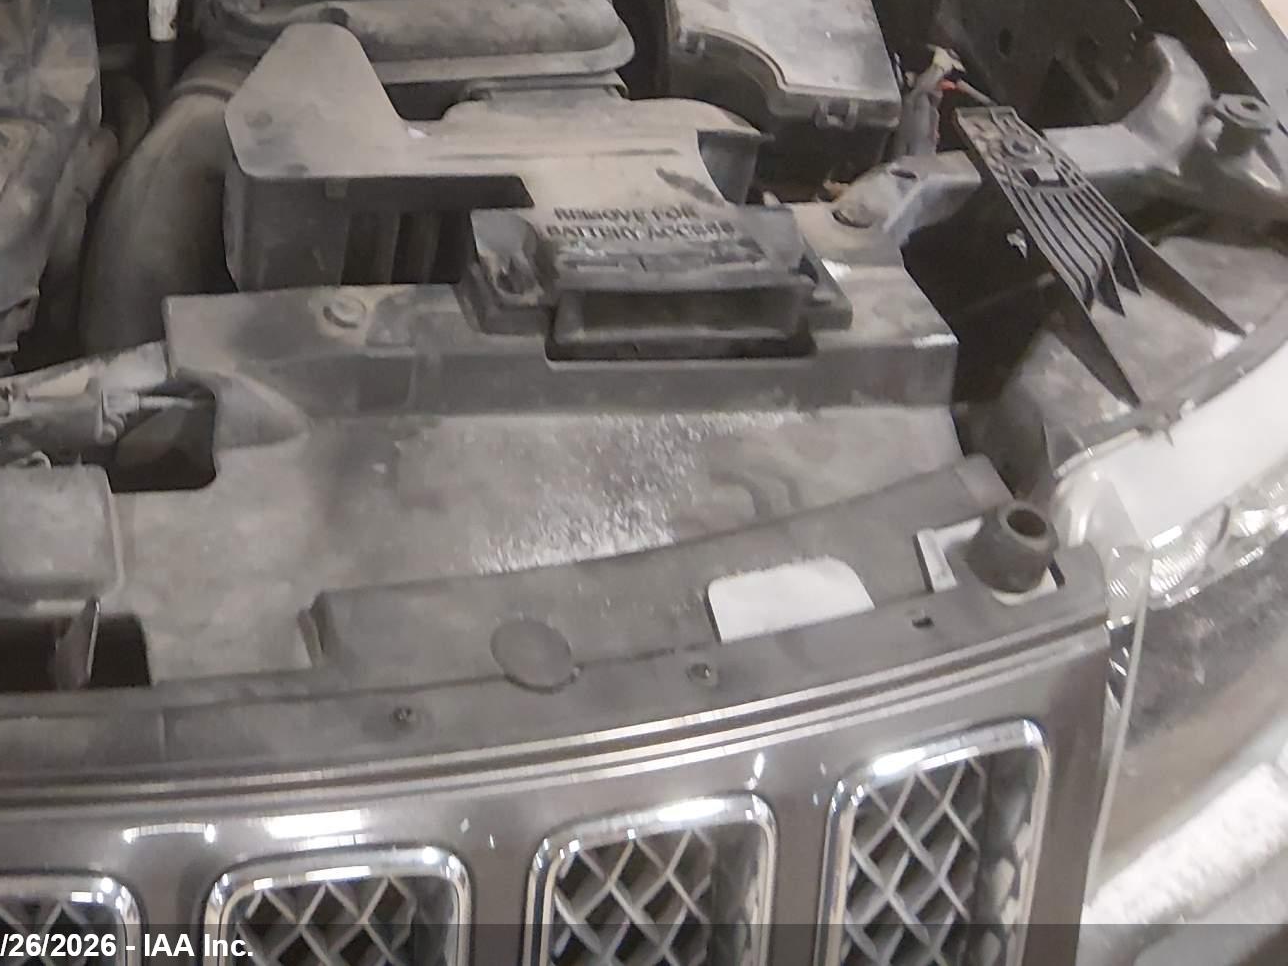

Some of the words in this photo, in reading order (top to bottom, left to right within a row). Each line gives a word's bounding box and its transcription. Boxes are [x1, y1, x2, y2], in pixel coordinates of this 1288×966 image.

[553, 207, 646, 223] REMOVE
[651, 203, 700, 221] FOR
[545, 223, 642, 241] BATTERY
[646, 220, 737, 240] ACCESS
